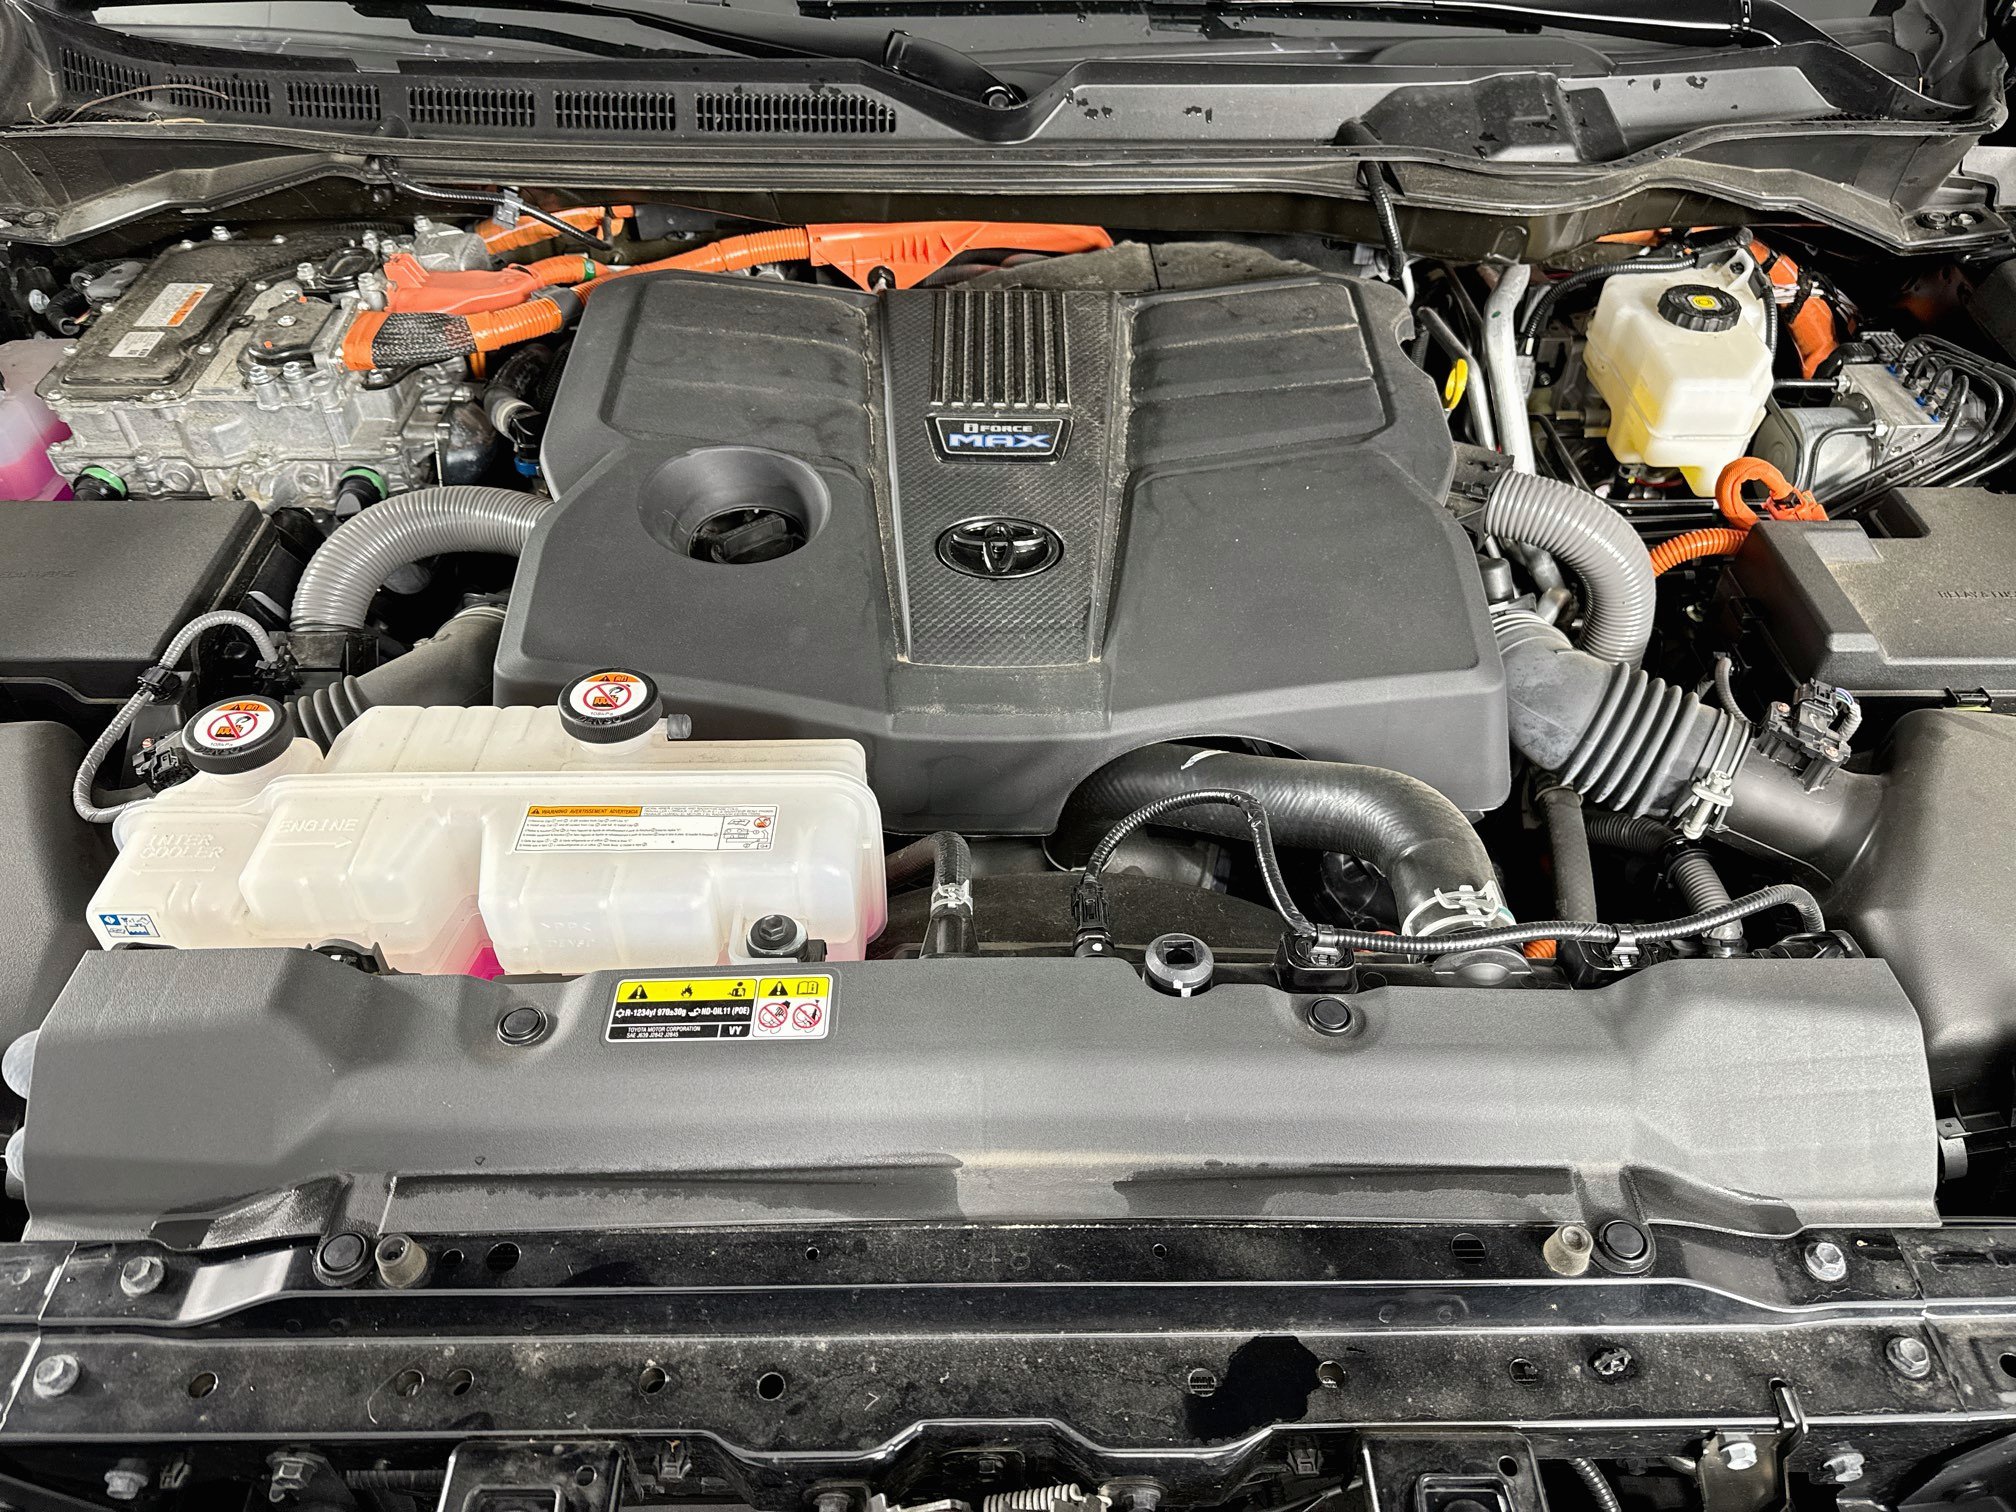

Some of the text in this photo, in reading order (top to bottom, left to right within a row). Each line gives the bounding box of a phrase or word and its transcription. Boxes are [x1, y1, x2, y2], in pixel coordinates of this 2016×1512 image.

[980, 425, 1033, 433] FORCE
[948, 433, 1051, 448] MAX
[277, 818, 359, 833] ENGINE
[149, 833, 215, 847] INTER
[139, 845, 225, 859] COOLER
[624, 1008, 657, 1018] R-1234yf
[657, 1008, 687, 1018] 970±30g
[731, 1006, 750, 1016] (POE)
[728, 1026, 742, 1036] VY
